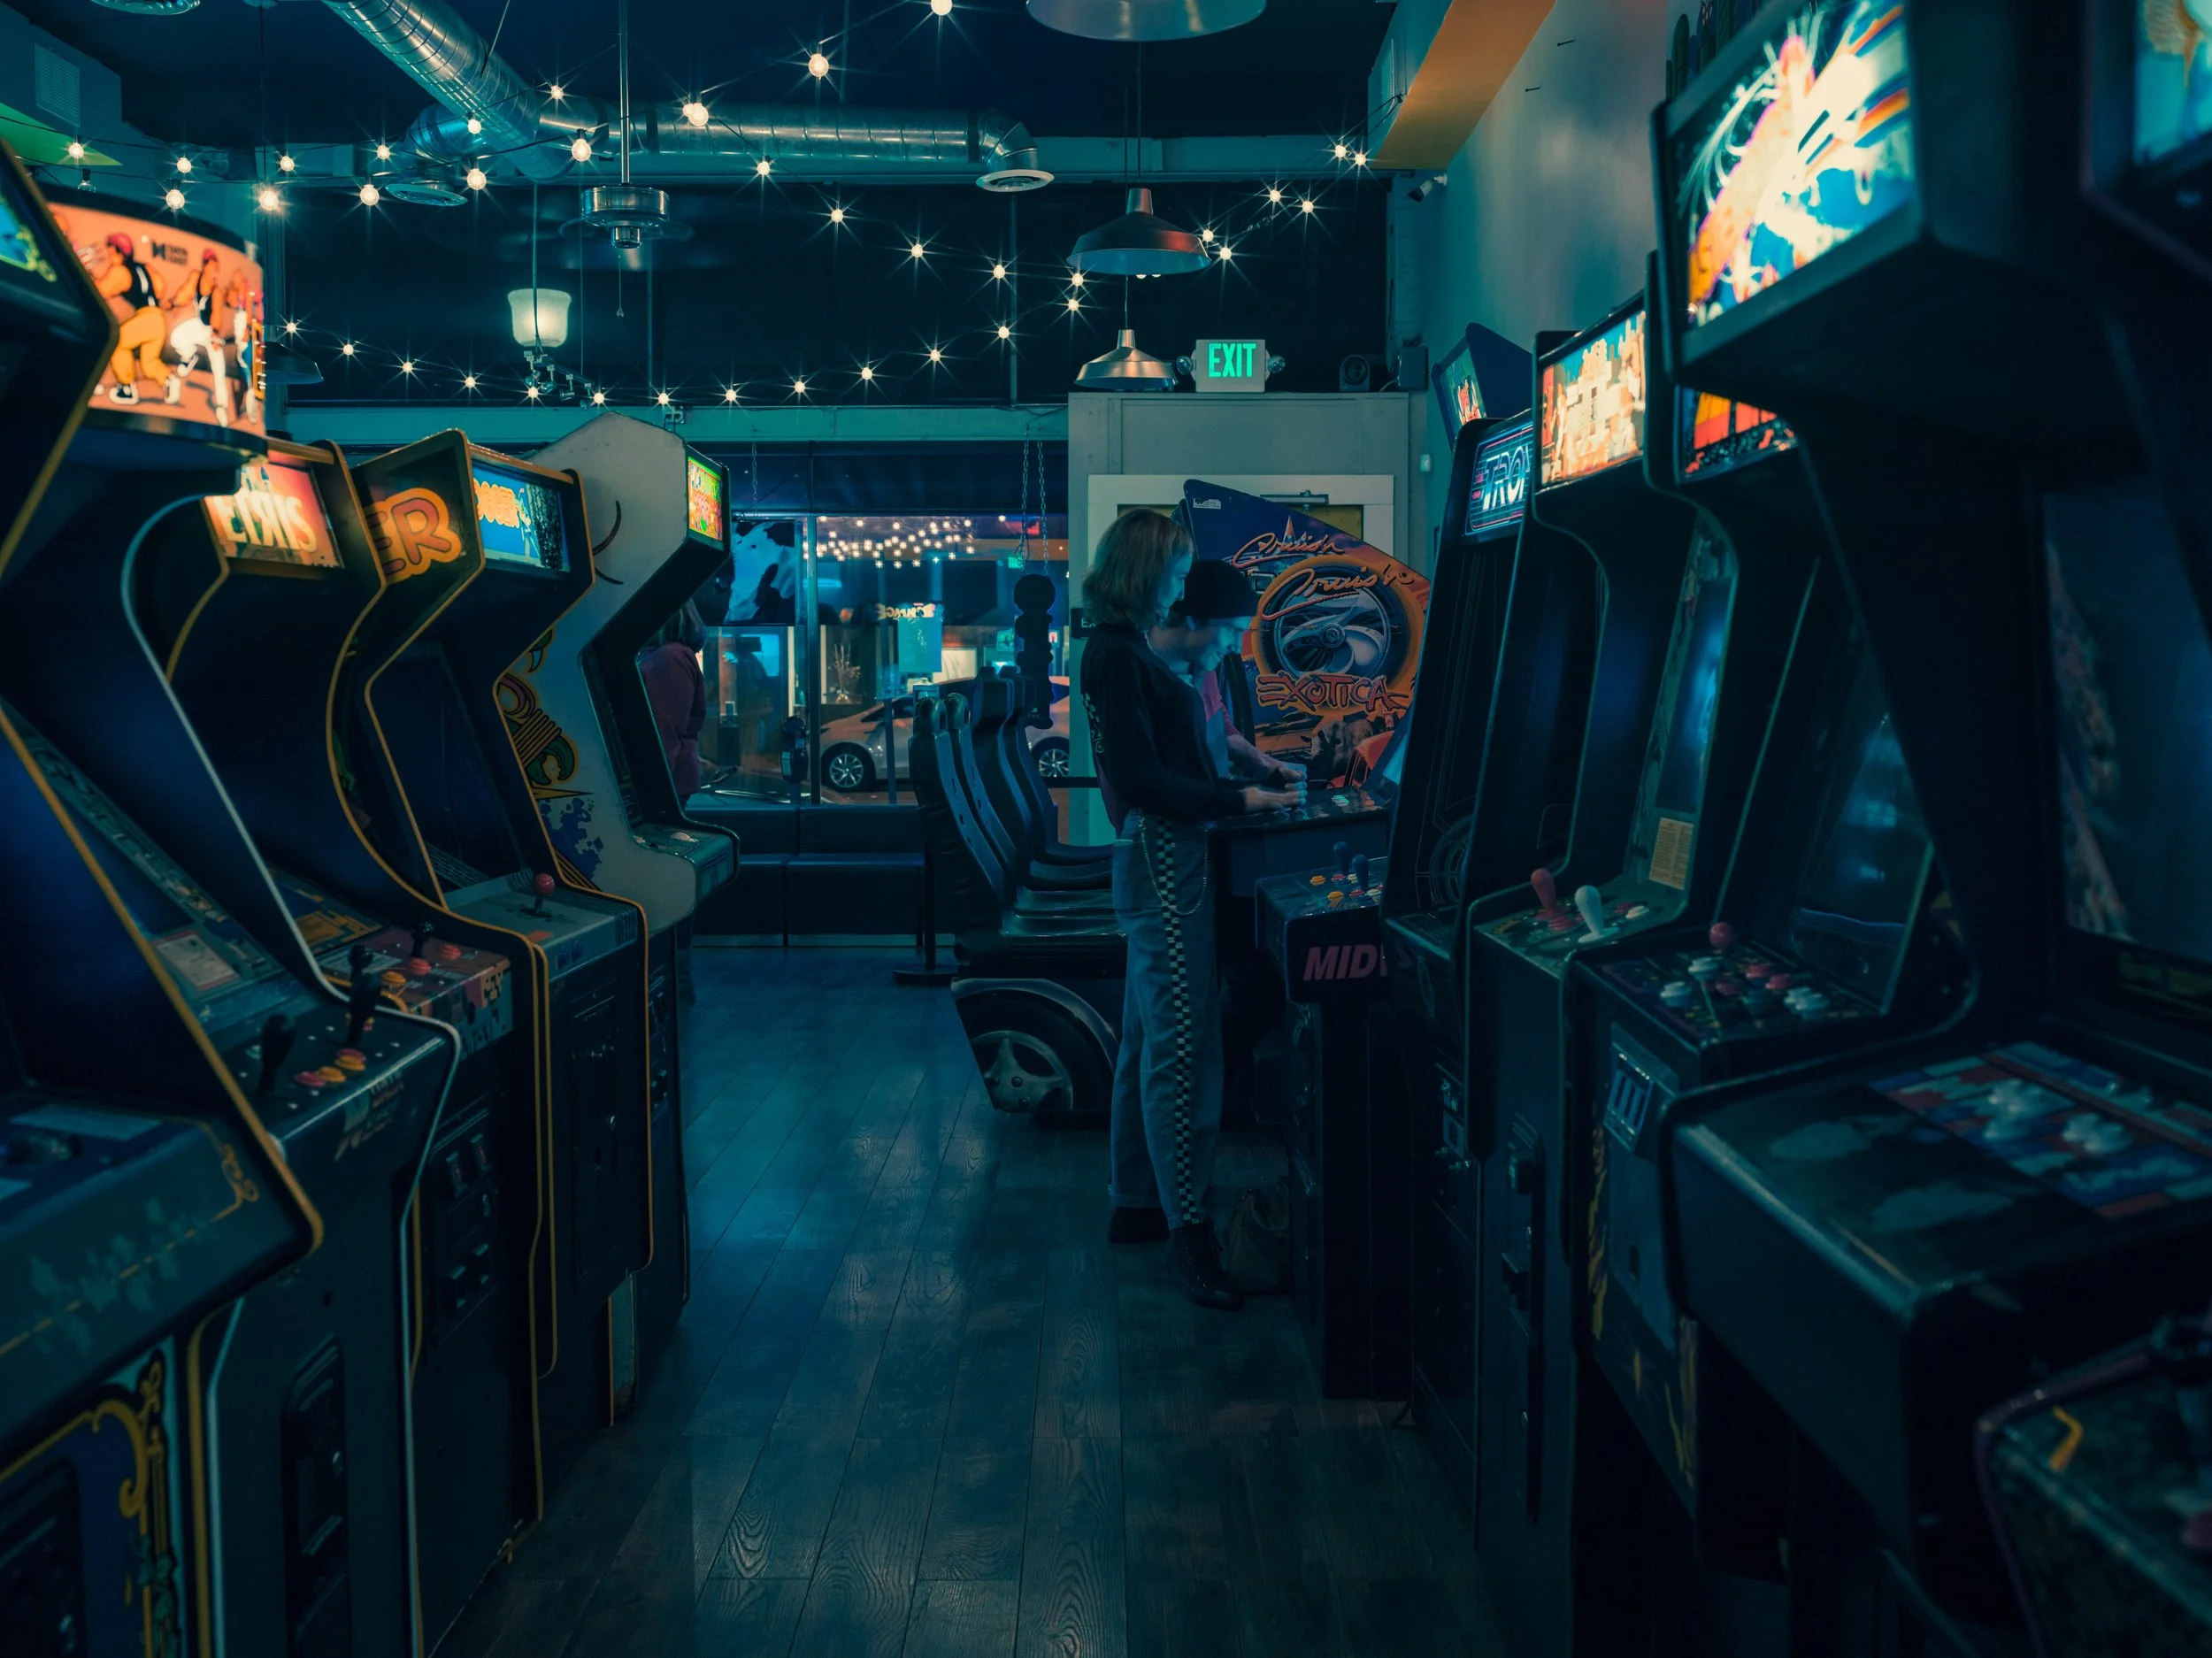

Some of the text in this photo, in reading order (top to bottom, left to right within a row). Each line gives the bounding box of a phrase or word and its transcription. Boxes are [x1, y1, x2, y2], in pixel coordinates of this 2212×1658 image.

[1209, 342, 1256, 378] EXIT
[1259, 564, 1416, 620] Cruis'n
[1256, 671, 1410, 714] EXOTICA
[1302, 942, 1388, 981] MID
